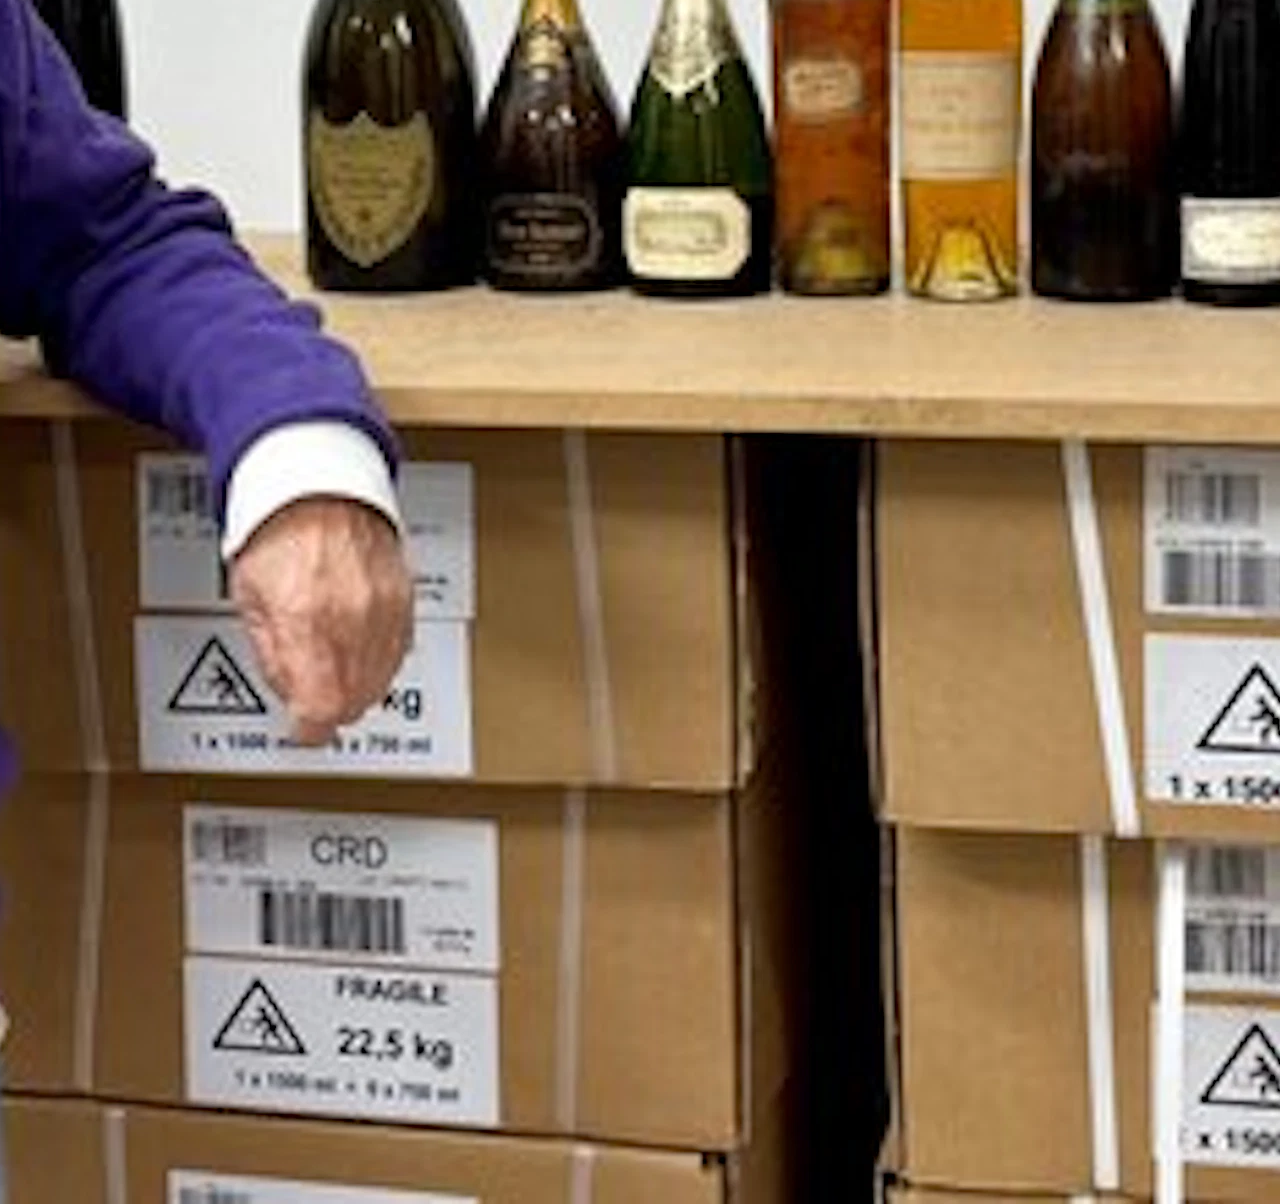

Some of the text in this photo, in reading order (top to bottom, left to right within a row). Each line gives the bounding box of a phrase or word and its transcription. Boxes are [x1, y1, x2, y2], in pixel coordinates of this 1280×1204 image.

[1169, 774, 1182, 796] 1
[1194, 780, 1211, 799] x
[309, 834, 389, 869] CRD
[336, 977, 448, 1006] FRAGILE
[338, 1027, 453, 1069] 22,5 kg
